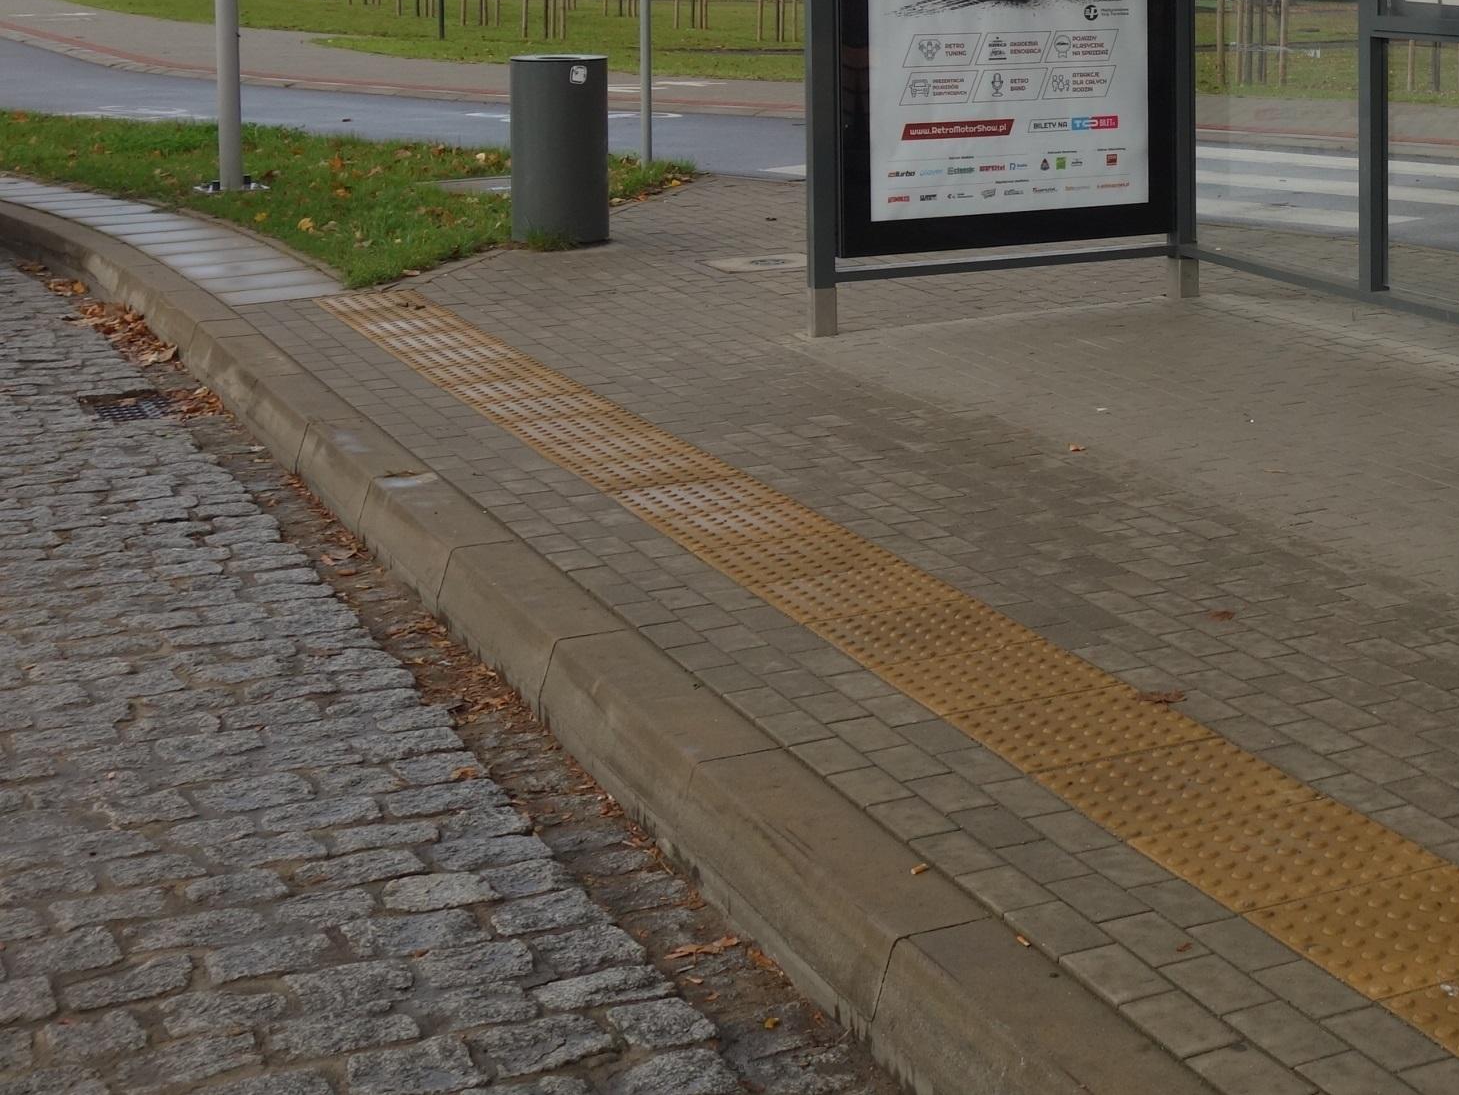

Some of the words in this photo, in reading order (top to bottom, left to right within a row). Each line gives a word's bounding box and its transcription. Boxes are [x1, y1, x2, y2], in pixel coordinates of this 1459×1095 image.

[944, 49, 967, 57] TUNING
[1072, 78, 1083, 86] DLA
[909, 123, 1007, 136] www.RetroMotorShow.pl
[1033, 121, 1057, 130] BILETY
[1057, 121, 1068, 129] NA
